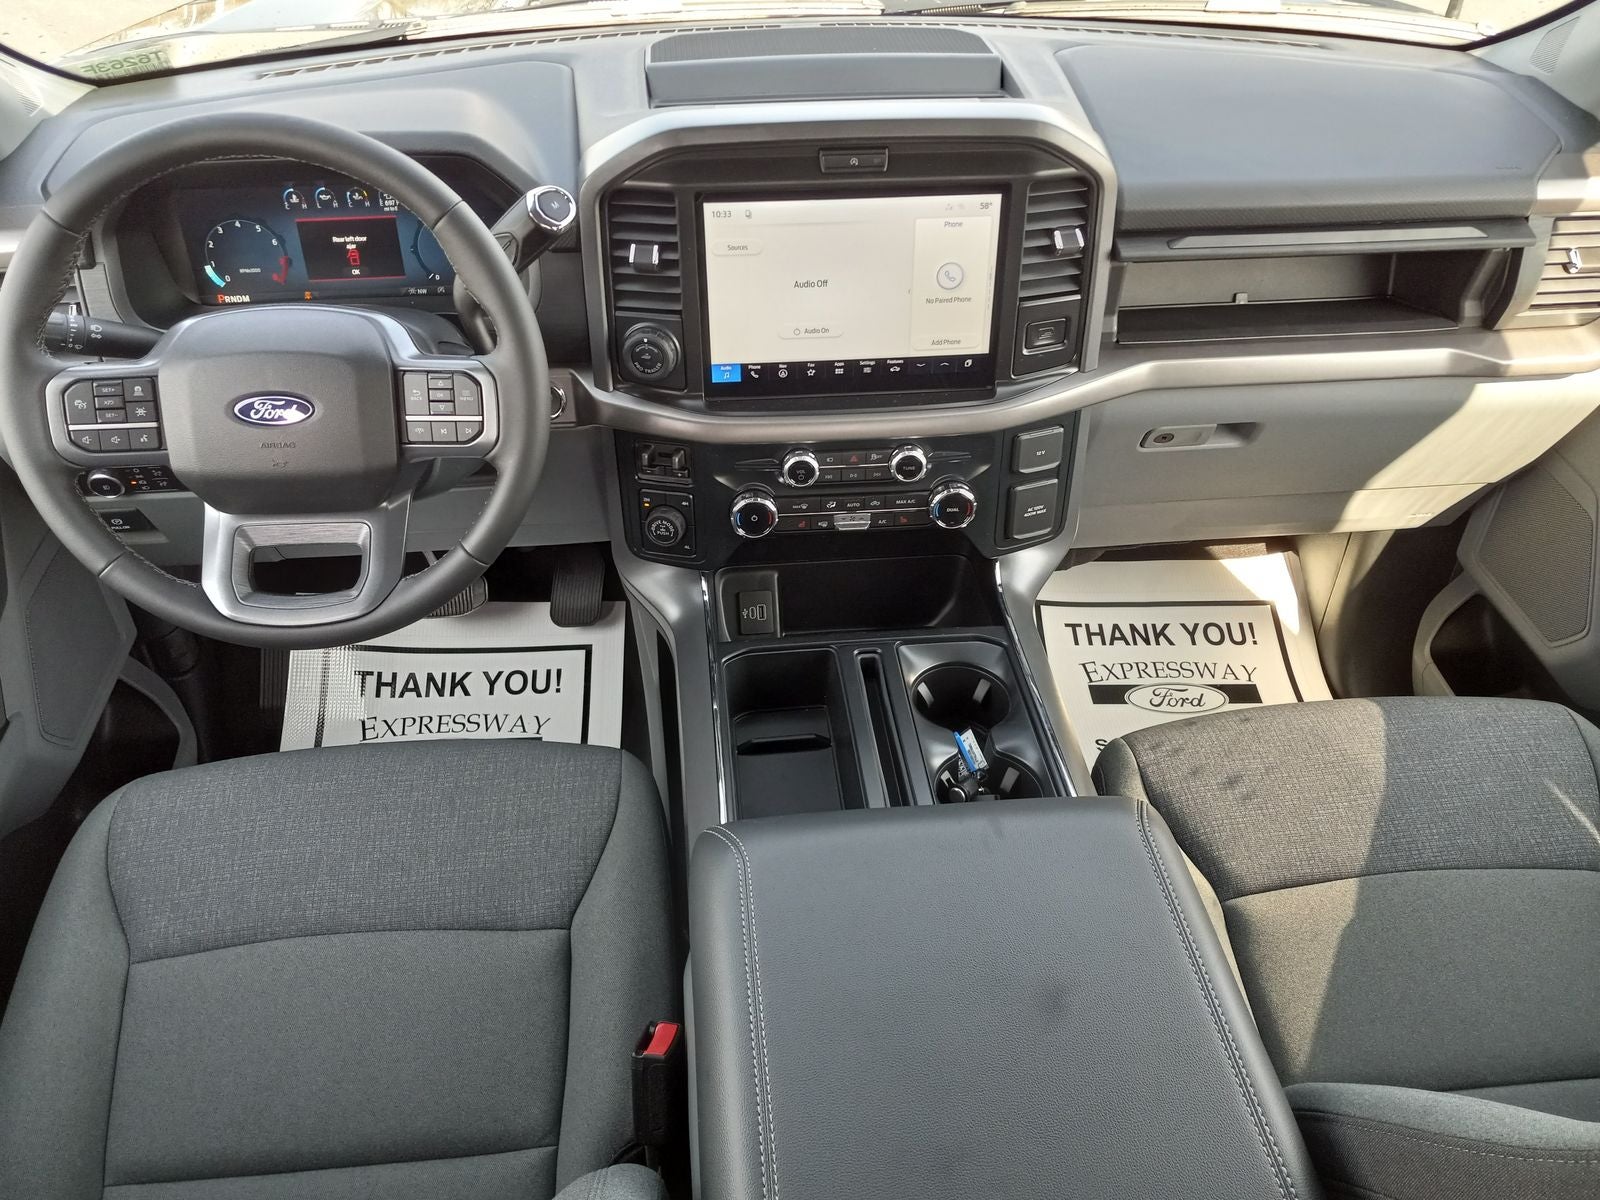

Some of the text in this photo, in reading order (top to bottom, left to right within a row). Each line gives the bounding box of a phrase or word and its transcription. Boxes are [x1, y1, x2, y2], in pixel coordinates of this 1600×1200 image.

[234, 220, 240, 228] 4
[712, 210, 732, 218] 10:33
[794, 279, 828, 288] Audio Off
[1064, 622, 1258, 646] THANK YOU!
[354, 668, 562, 698] THANK YOU!
[1078, 660, 1257, 684] EXPRESSWAY
[1150, 687, 1206, 708] Ford
[360, 713, 551, 742] EXPRESSWAY
